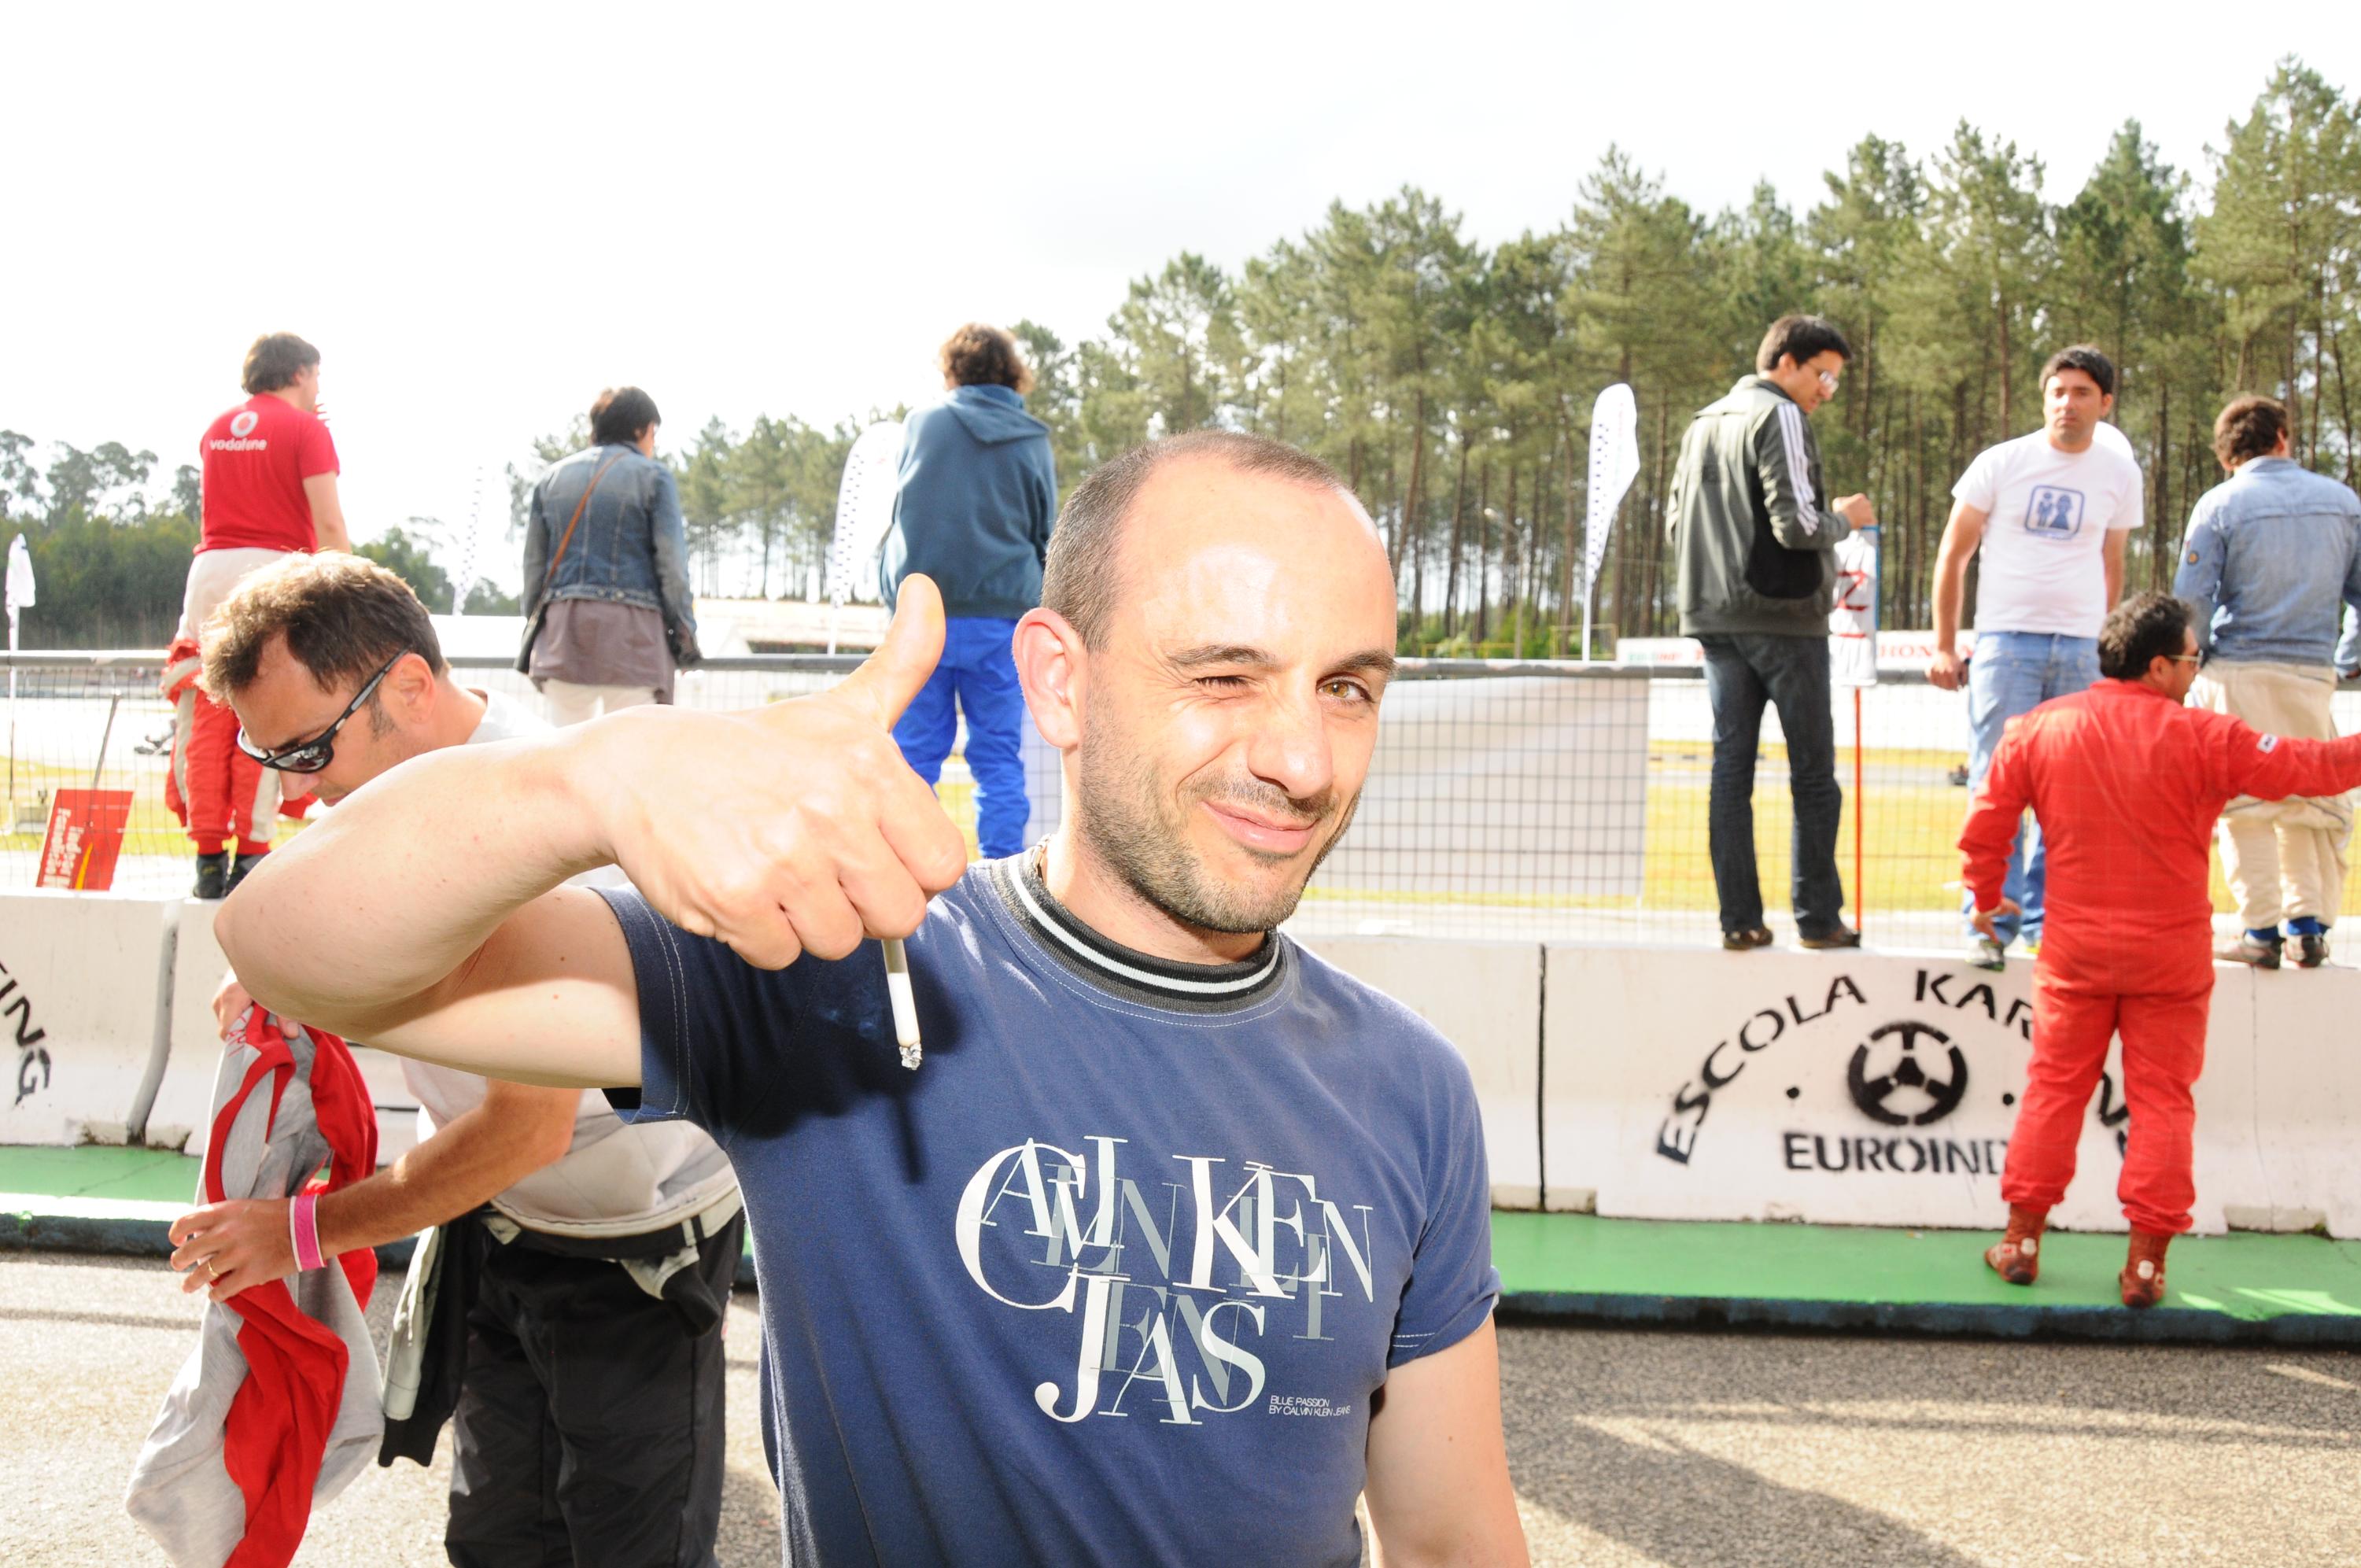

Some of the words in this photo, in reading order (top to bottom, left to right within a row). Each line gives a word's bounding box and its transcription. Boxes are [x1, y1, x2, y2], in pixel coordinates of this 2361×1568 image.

[209, 437, 267, 451] vodafone
[1880, 644, 1974, 658] HONA
[0, 962, 51, 1105] ING
[1655, 973, 1868, 1166] ESCOLA
[1783, 1131, 2009, 1174] EUROIND
[1270, 1395, 1294, 1406] BLUE
[1295, 1396, 1330, 1408] PASSION
[1268, 1404, 1282, 1415] BY
[1282, 1406, 1313, 1416] CALVIN
[1313, 1407, 1333, 1417] KLEIN
[1333, 1404, 1352, 1417] JEANS
